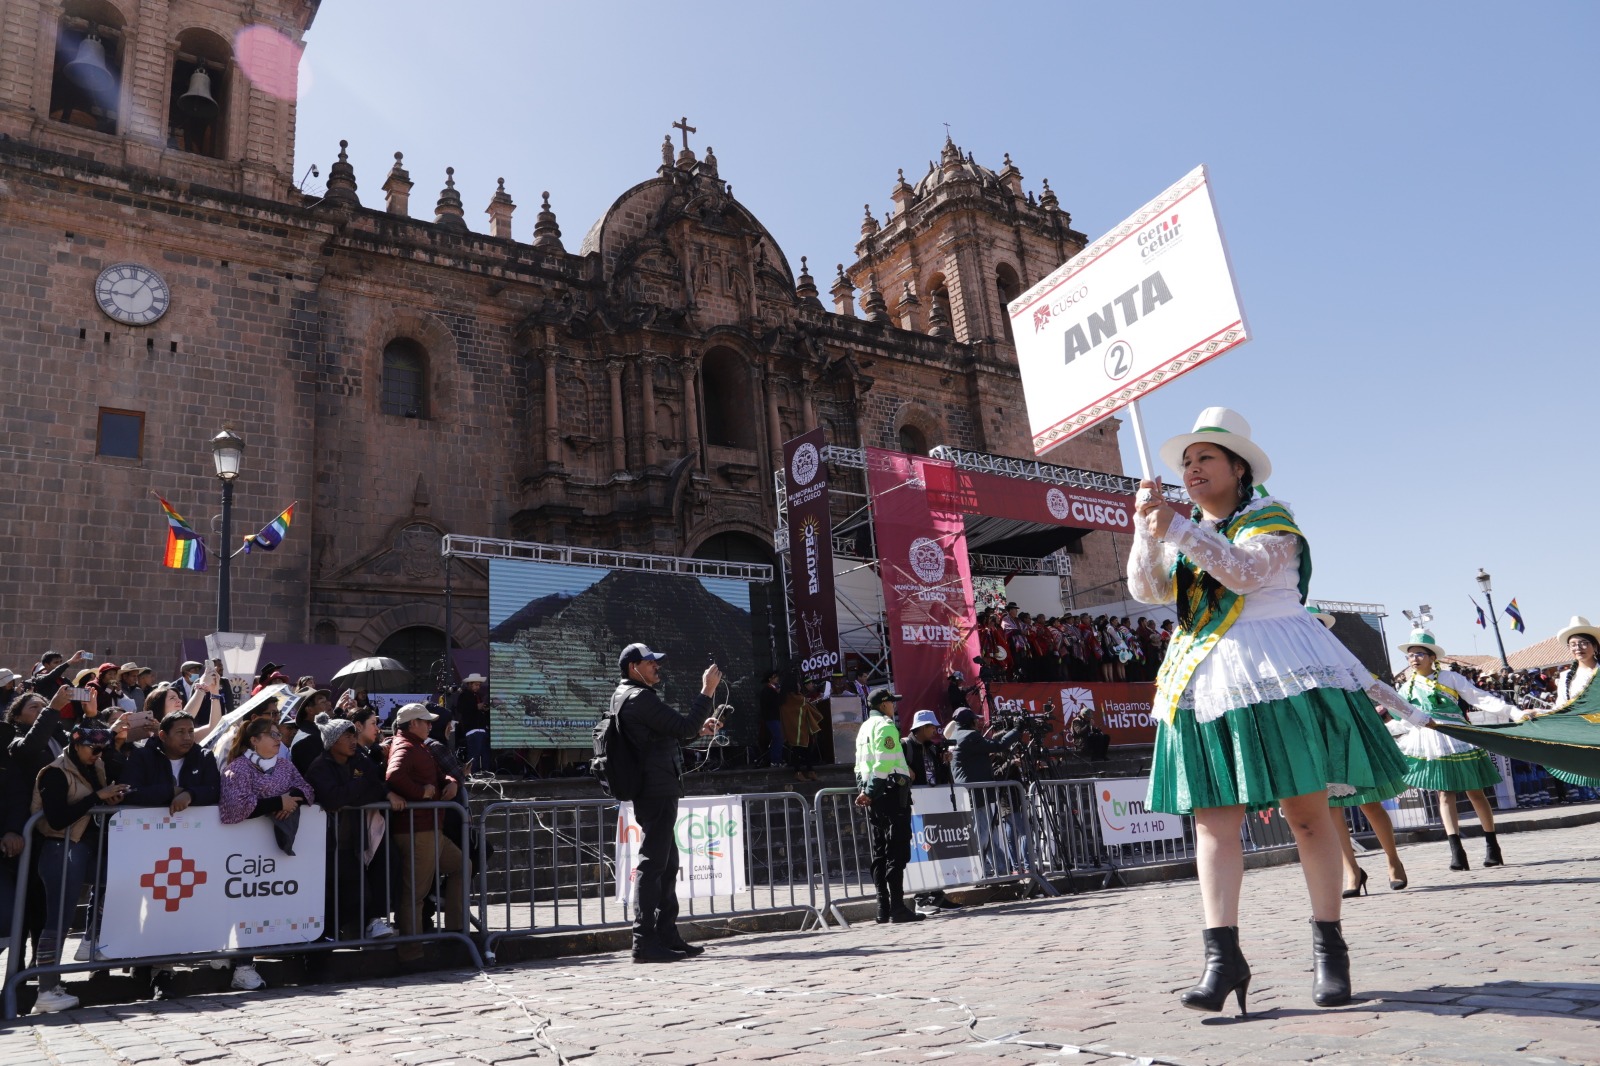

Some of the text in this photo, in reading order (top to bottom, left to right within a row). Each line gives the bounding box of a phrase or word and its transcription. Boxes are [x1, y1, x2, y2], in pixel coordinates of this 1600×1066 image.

[1137, 223, 1163, 246] Ger
[1141, 224, 1182, 258] cetur
[1052, 286, 1088, 316] CUSCO
[1065, 270, 1174, 365] ANTA
[1110, 345, 1128, 377] 2
[789, 481, 826, 502] MUNICIPALIDAD
[794, 490, 821, 506] DEL CUSCO
[1072, 502, 1128, 527] CUSCO
[804, 524, 818, 595] EMUFEC
[919, 592, 946, 602] CUSCO
[901, 624, 960, 642] EMUFEC
[801, 652, 838, 672] QOSQO
[1105, 700, 1150, 714] Hagamos
[1108, 713, 1158, 728] HISTOR
[674, 814, 738, 854] Cable
[1131, 820, 1164, 834] 21.1 HD
[225, 853, 275, 877] Caja
[690, 872, 722, 880] EXCLUSIVO
[224, 877, 298, 898] Cusco
